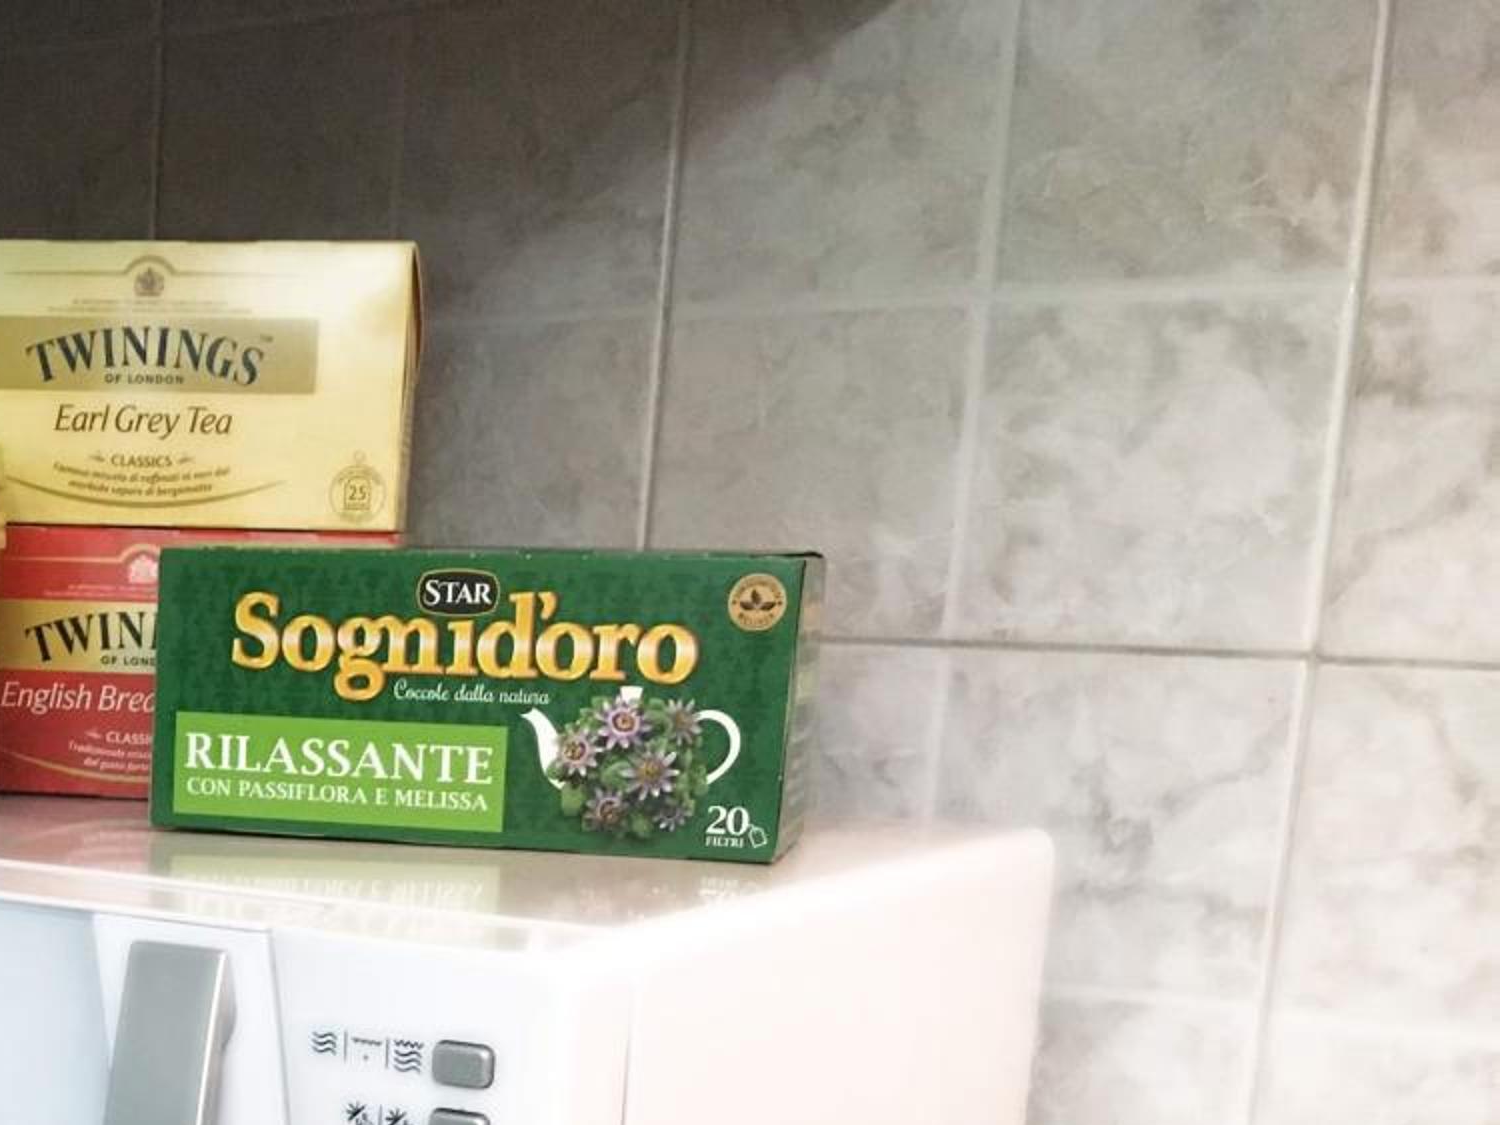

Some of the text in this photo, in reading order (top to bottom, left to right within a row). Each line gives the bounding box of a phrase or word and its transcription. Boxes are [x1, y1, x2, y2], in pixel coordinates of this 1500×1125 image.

[25, 325, 266, 387] TWININGS
[104, 372, 185, 386] OF LONDON
[54, 404, 234, 440] Earl Grey Tea
[111, 454, 173, 468] CLASSICS
[348, 485, 367, 501] 25
[423, 579, 493, 606] STAR
[1, 681, 92, 715] English
[393, 677, 450, 701] Coccole
[499, 688, 550, 705] natura
[184, 731, 494, 785] RILASSANTE
[187, 776, 489, 812] CON PASSIFLORA E MELISSA
[705, 805, 750, 836] 20
[705, 836, 745, 849] FILTRI
